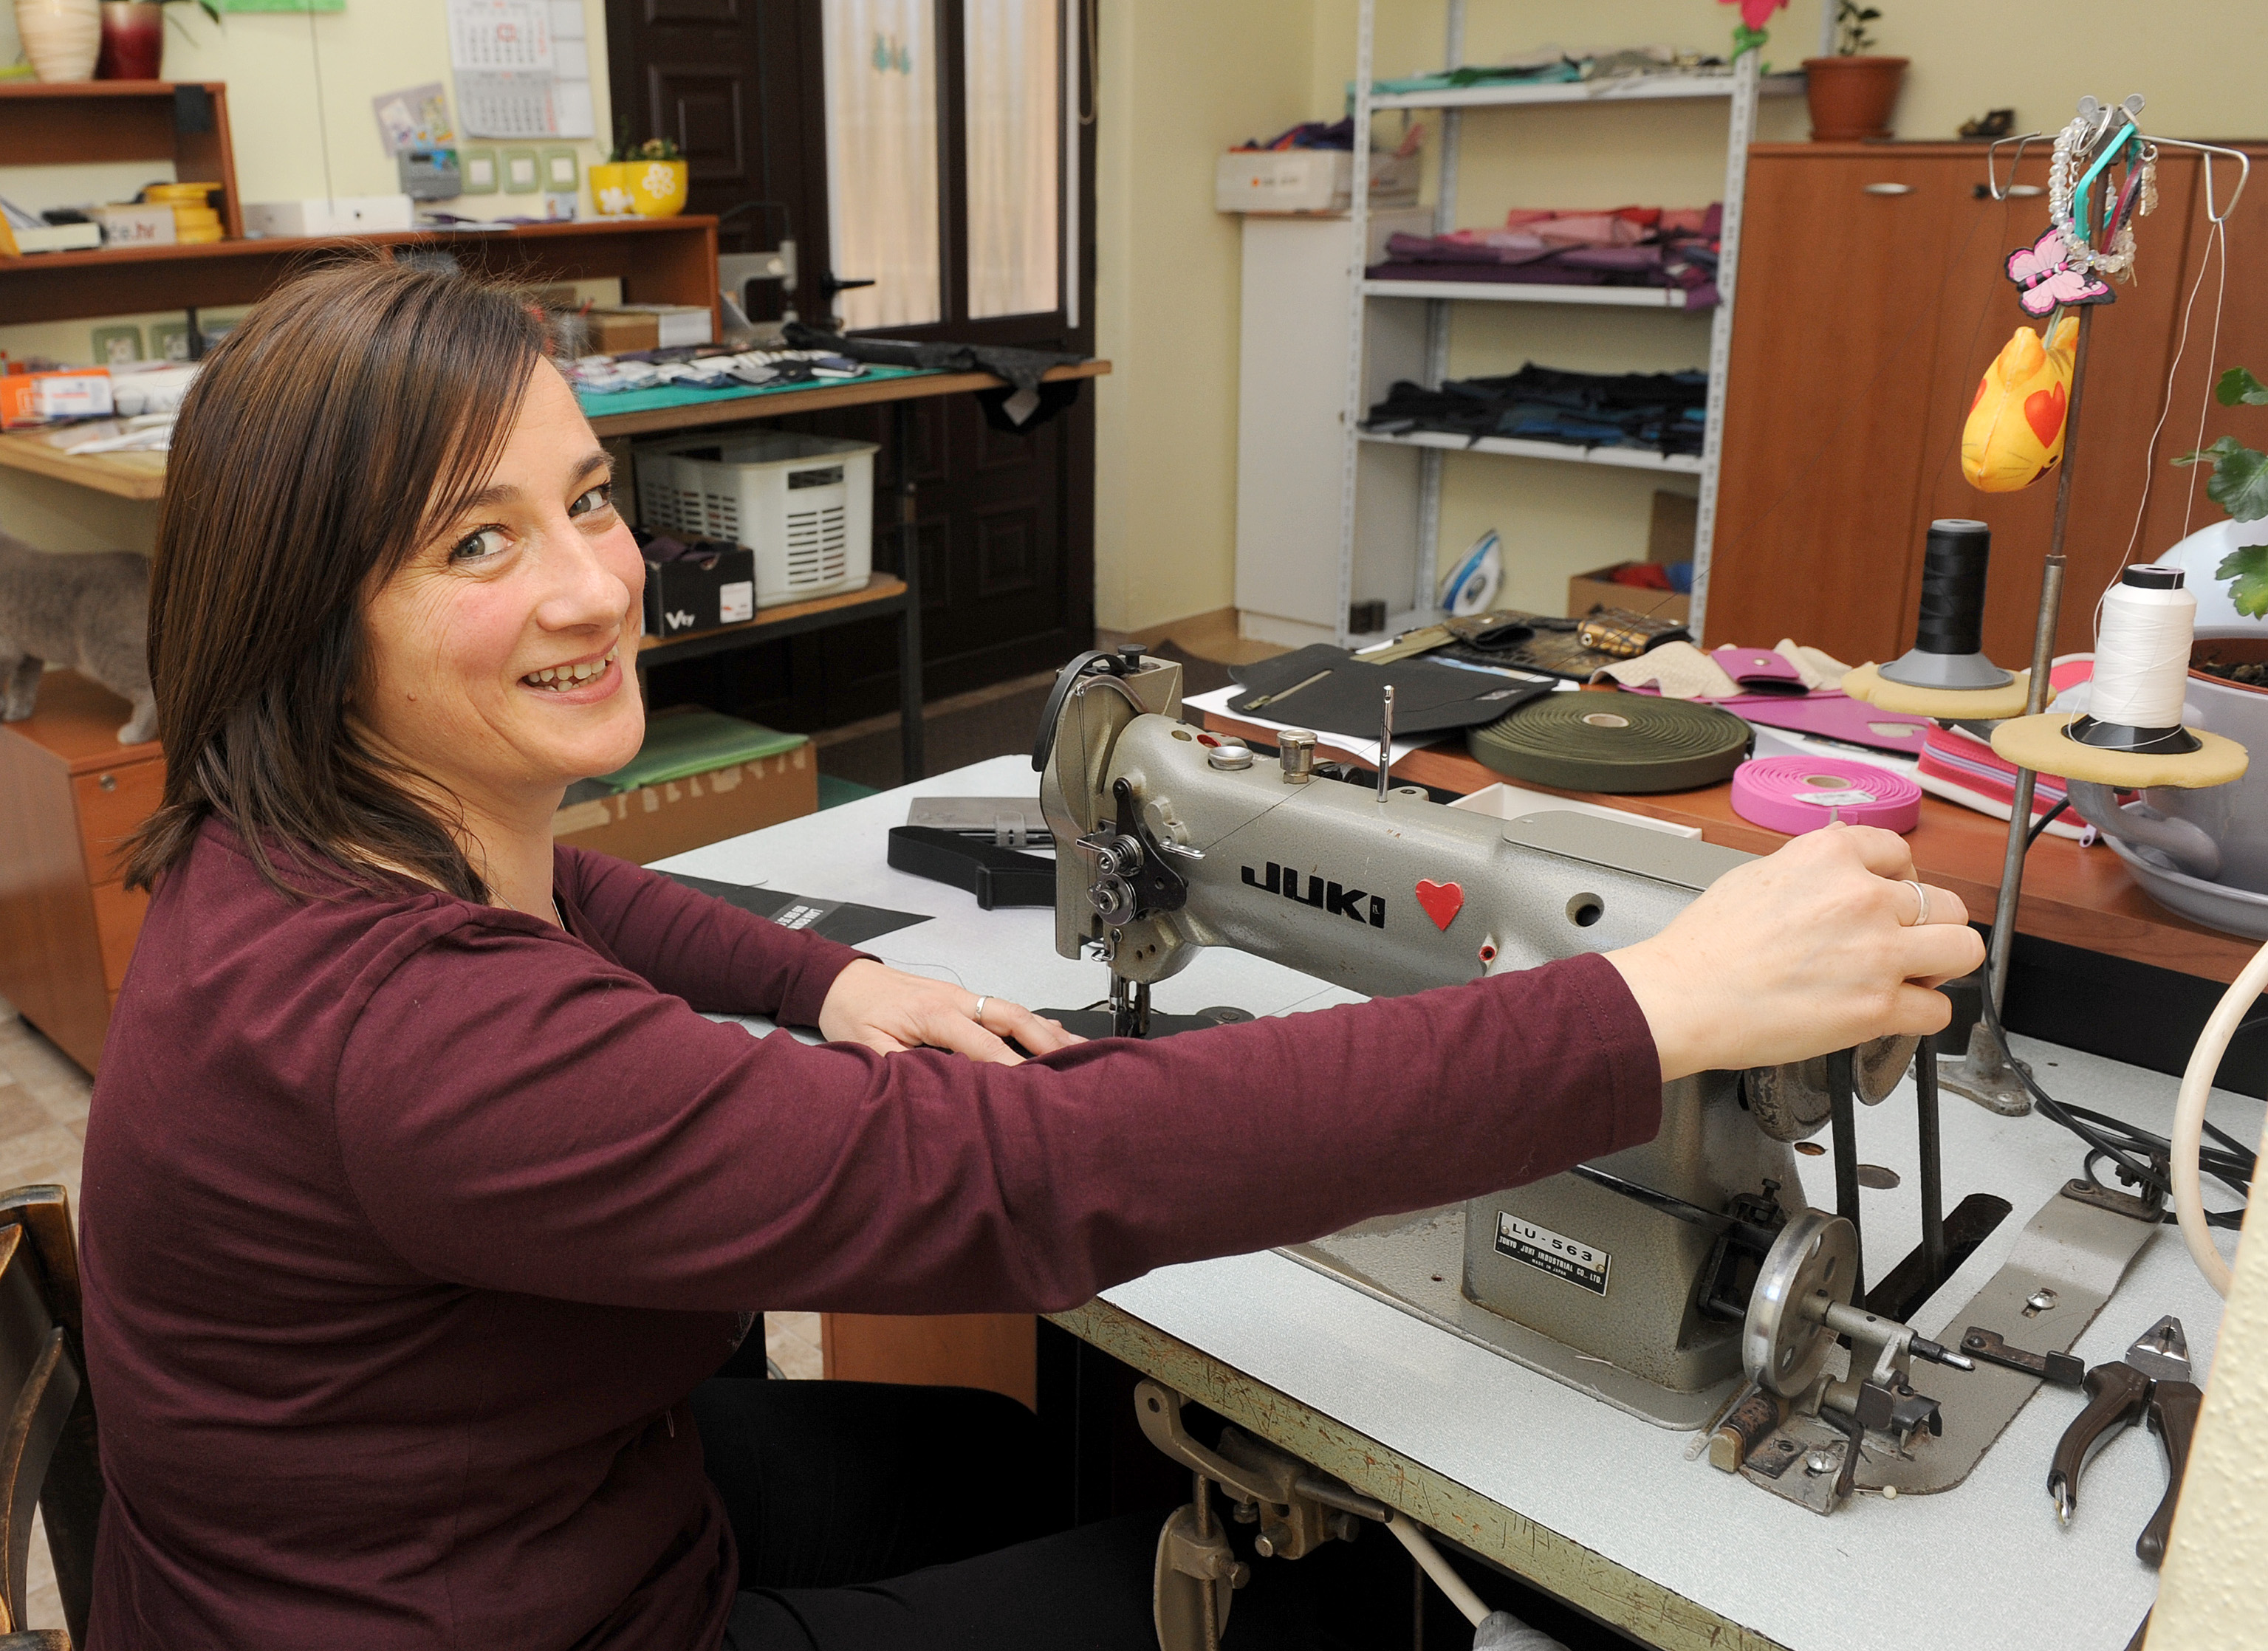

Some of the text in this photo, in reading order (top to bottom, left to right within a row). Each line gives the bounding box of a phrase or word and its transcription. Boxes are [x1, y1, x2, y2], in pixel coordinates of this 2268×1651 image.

[1241, 861, 1385, 929] JUKI
[1498, 1236, 1517, 1249] TOKYO
[1521, 1245, 1535, 1256] JUKI
[1538, 1252, 1573, 1272] INDUSTRIAL
[1512, 1223, 1592, 1262] LU-563
[1553, 1268, 1566, 1276] JAPAN
